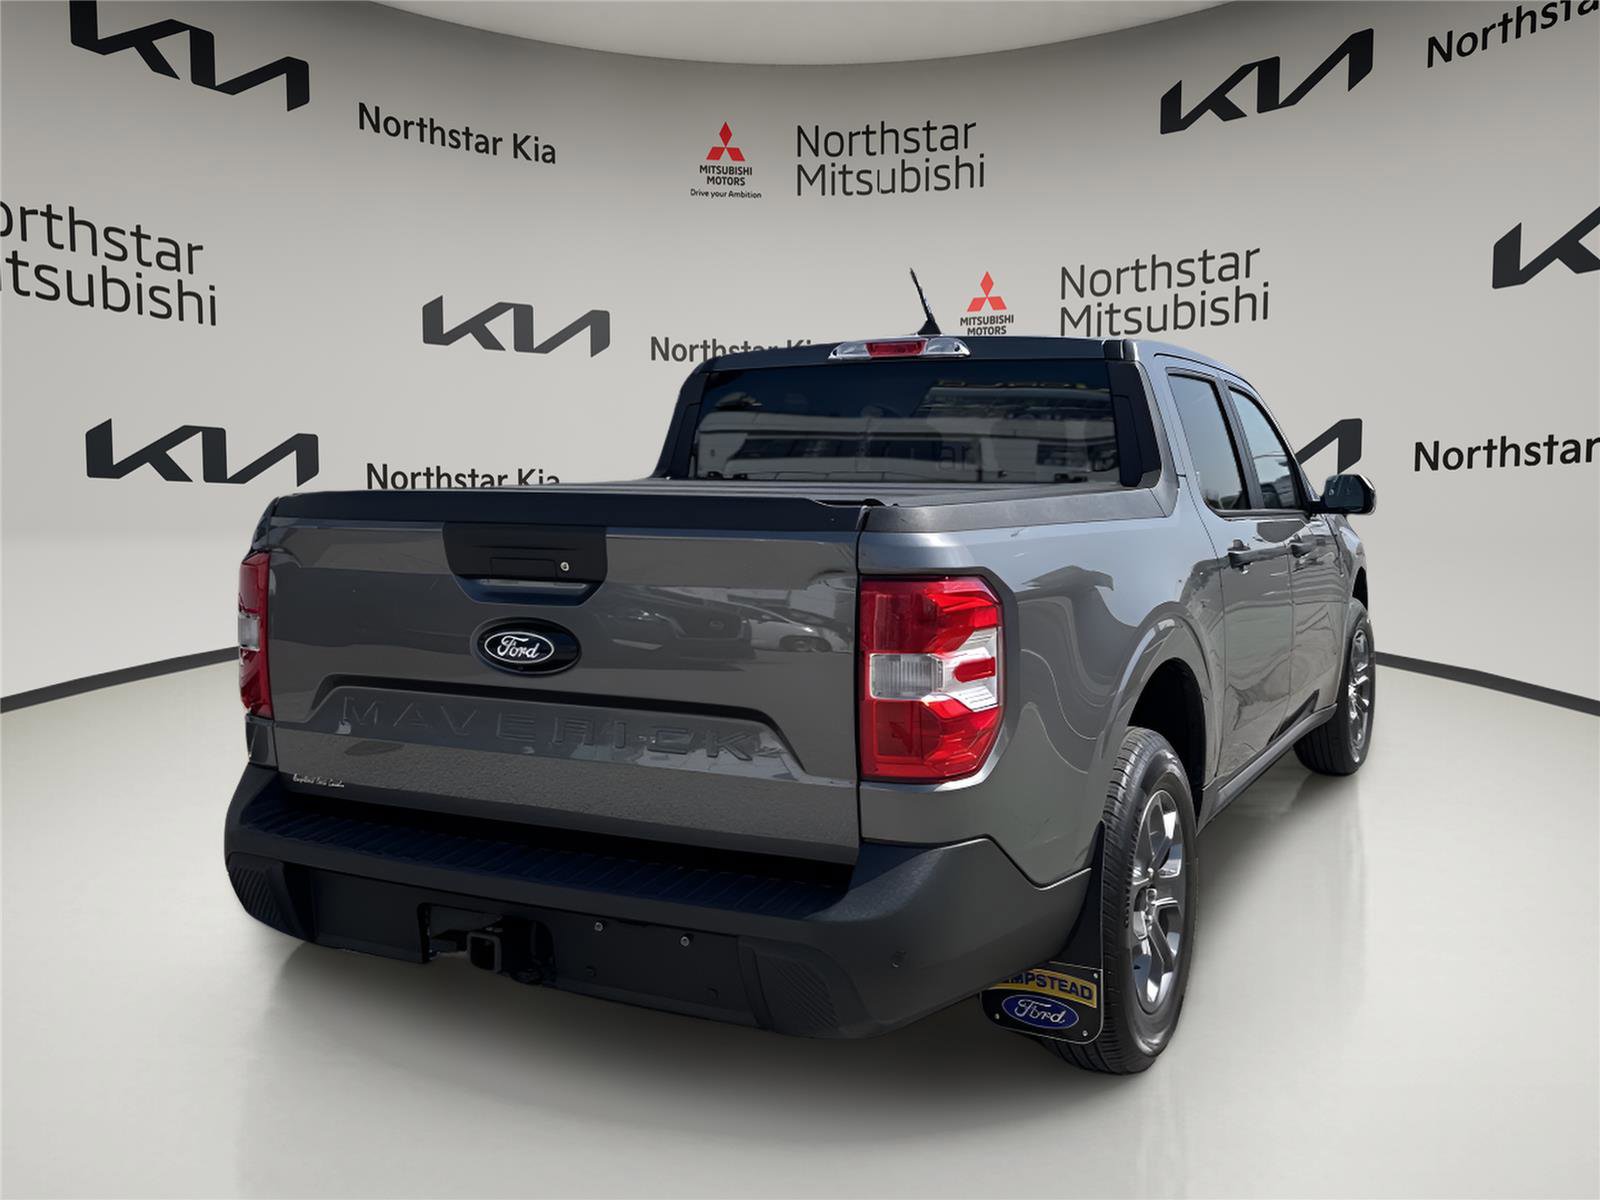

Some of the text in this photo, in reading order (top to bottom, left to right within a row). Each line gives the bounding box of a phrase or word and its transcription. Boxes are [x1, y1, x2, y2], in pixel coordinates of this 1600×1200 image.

[1160, 28, 1374, 135] KIA
[358, 102, 556, 165] Northstar Kia
[797, 120, 977, 157] Northstar
[699, 164, 753, 176] MITSUBISHI
[706, 175, 746, 187] MOTORS
[797, 153, 985, 196] Mitsubishi
[690, 188, 762, 199] Drive your Ambition
[1060, 248, 1261, 300] Northstar
[422, 295, 610, 357] KIA
[960, 314, 1015, 327] MITSUBISHI
[1060, 281, 1270, 337] Mitsubishi
[967, 325, 1008, 336] MOTORS
[85, 418, 320, 488] KIA
[1414, 434, 1600, 472] Northstar
[366, 463, 509, 490] Northstar
[497, 635, 541, 659] Ford
[341, 695, 754, 762] MAVERICK
[1014, 999, 1068, 1024] Ford
